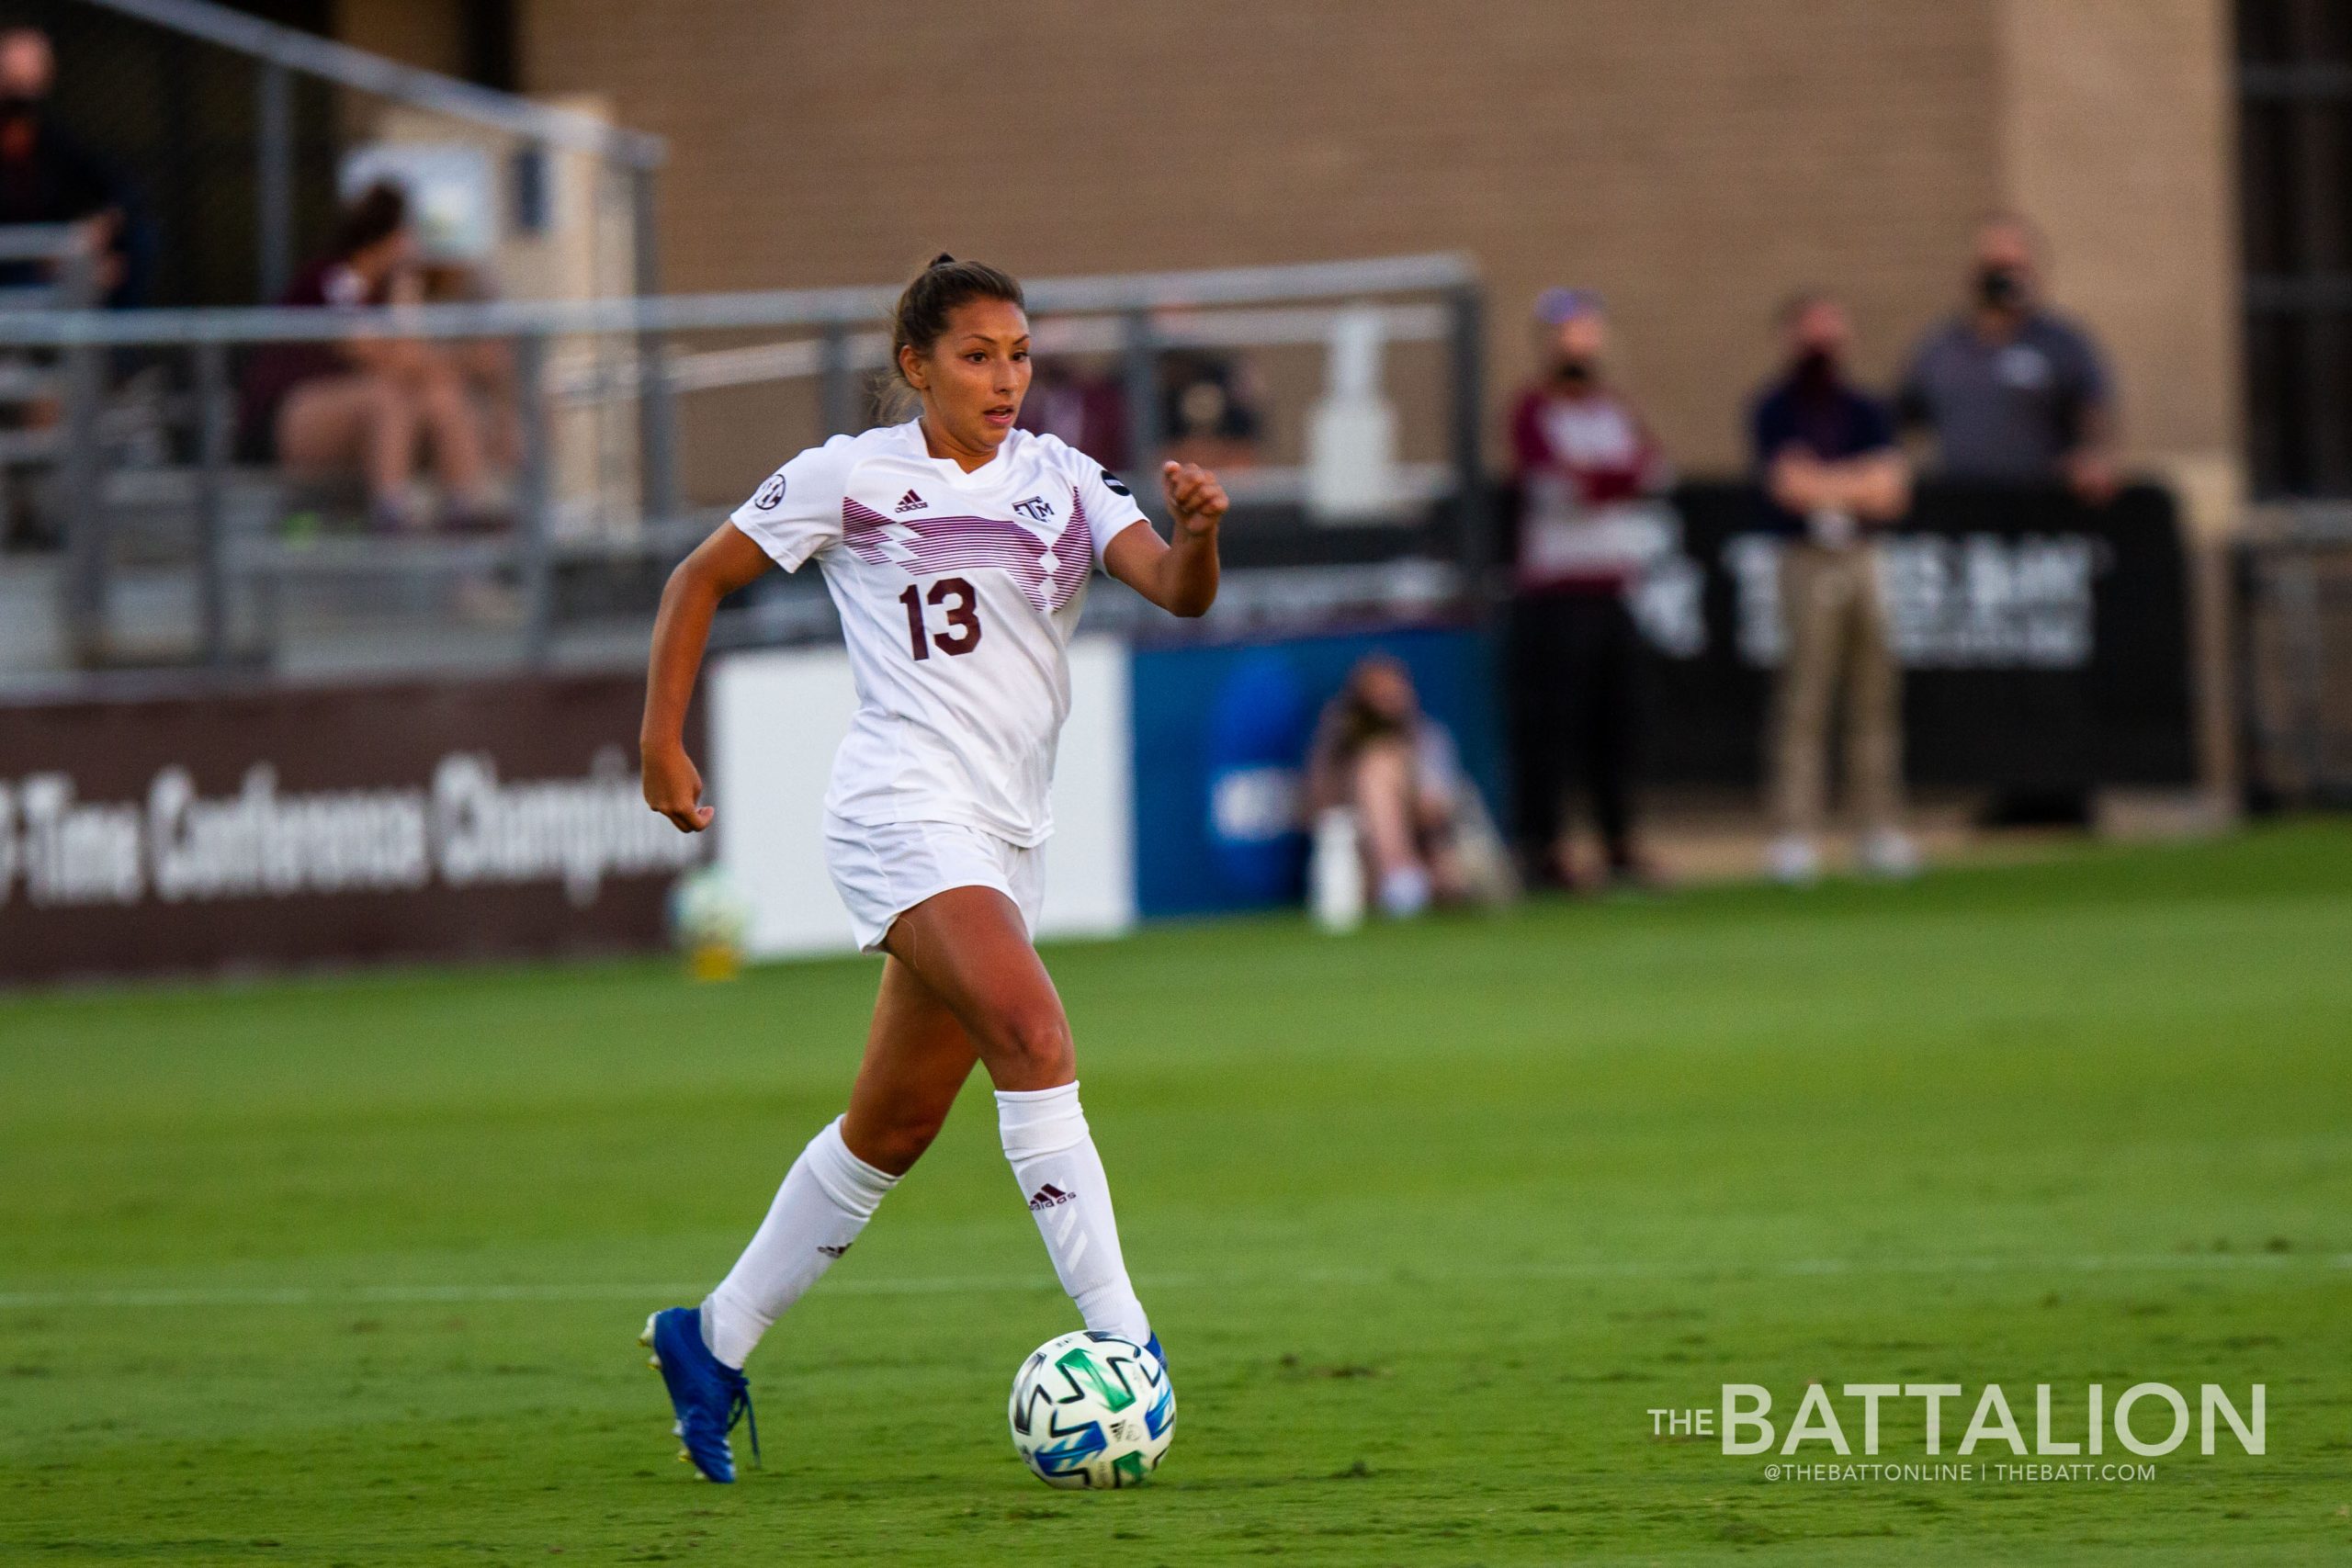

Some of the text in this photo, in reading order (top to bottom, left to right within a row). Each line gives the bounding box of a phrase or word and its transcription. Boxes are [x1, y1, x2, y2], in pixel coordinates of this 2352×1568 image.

[895, 502, 928, 513] adidas
[899, 578, 981, 660] 13
[151, 764, 427, 899] Conference
[1029, 1190, 1077, 1211] adidas
